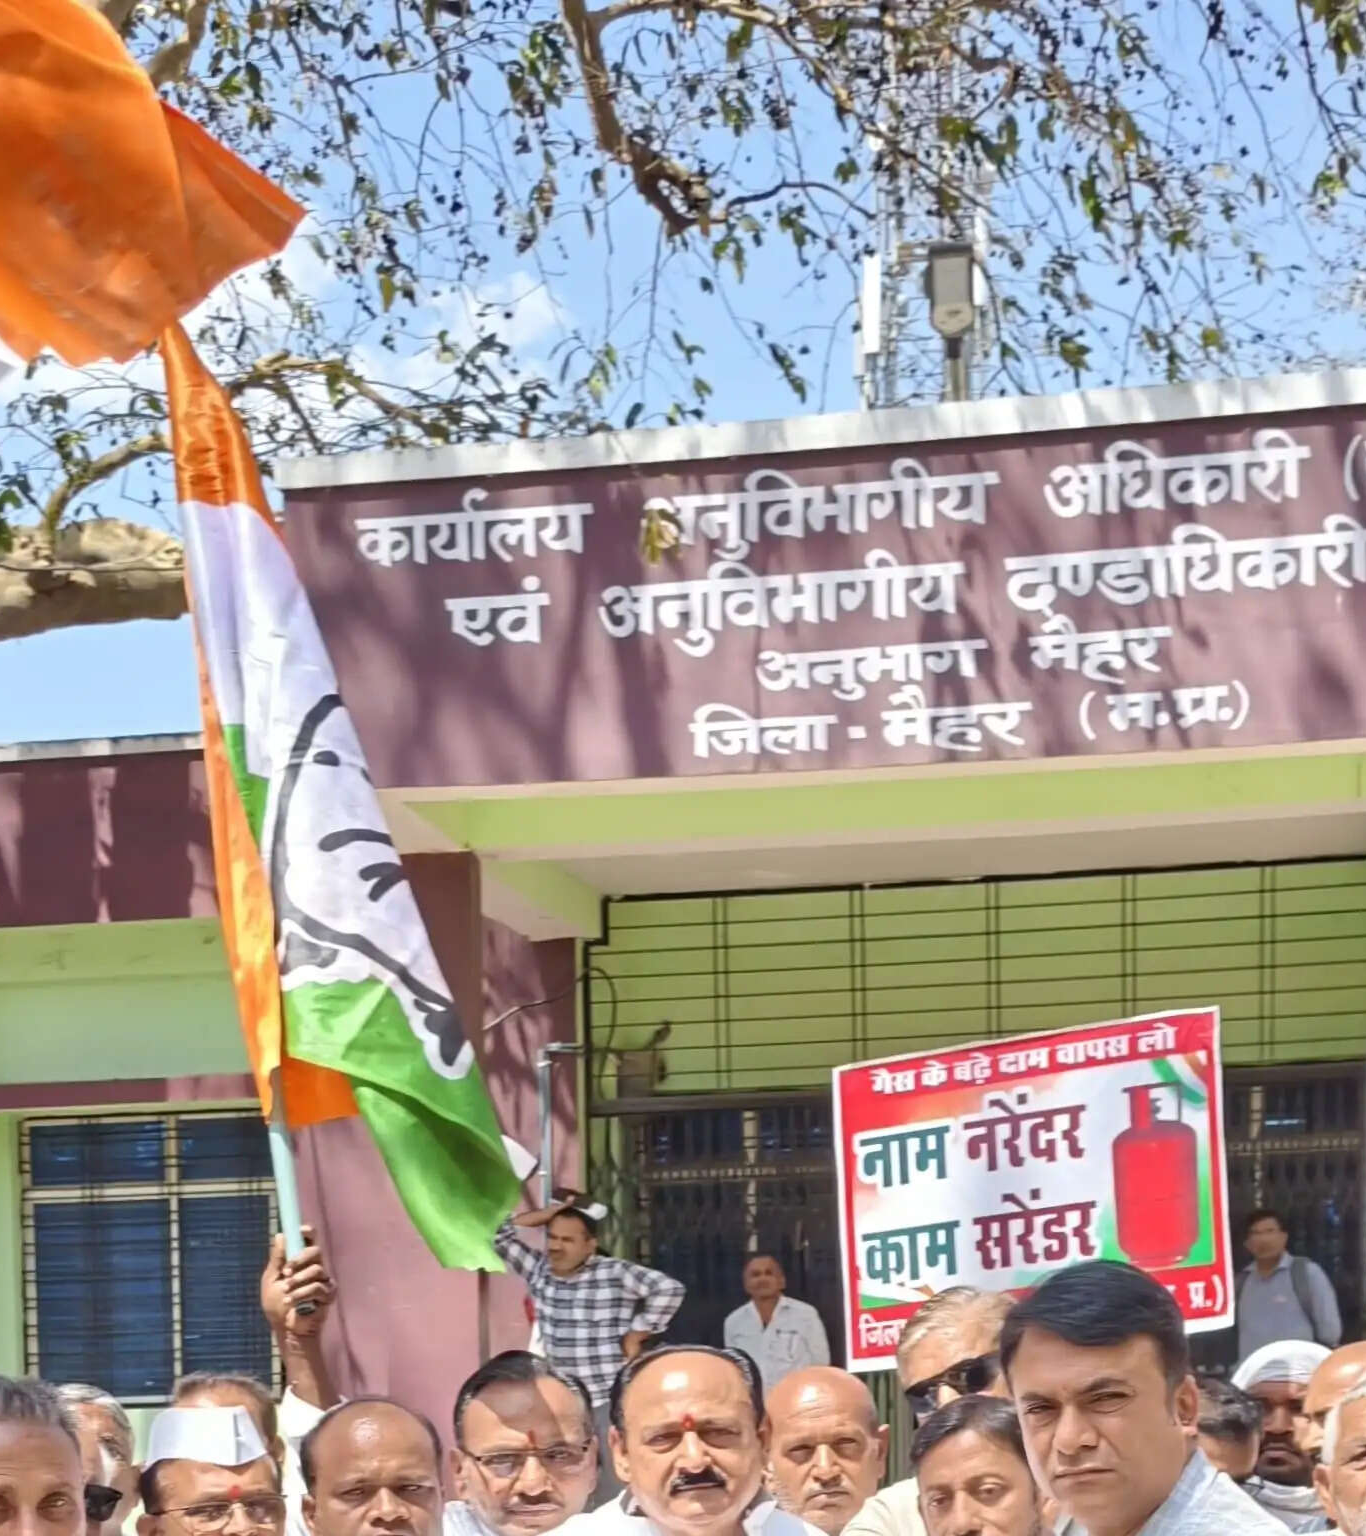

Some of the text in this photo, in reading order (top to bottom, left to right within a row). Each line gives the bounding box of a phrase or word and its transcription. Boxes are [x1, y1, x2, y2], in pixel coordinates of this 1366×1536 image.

[356, 489, 593, 566] कार्यालय
[1045, 429, 1310, 518] अधिकारी
[446, 575, 549, 646] एवं
[599, 549, 965, 657] अनुविभागीय
[757, 613, 1173, 700] अनुभाग मैहर
[689, 703, 838, 758] जिला
[882, 684, 1032, 752] मैहर
[920, 1061, 948, 1088] के
[953, 1055, 992, 1085] बढ़े
[999, 1047, 1049, 1074] दाम
[1056, 1034, 1130, 1066] वापस
[1136, 1022, 1178, 1053] लो
[860, 1092, 1087, 1187] नाम नरेंदर
[862, 1187, 1097, 1285] काम सरेंडर
